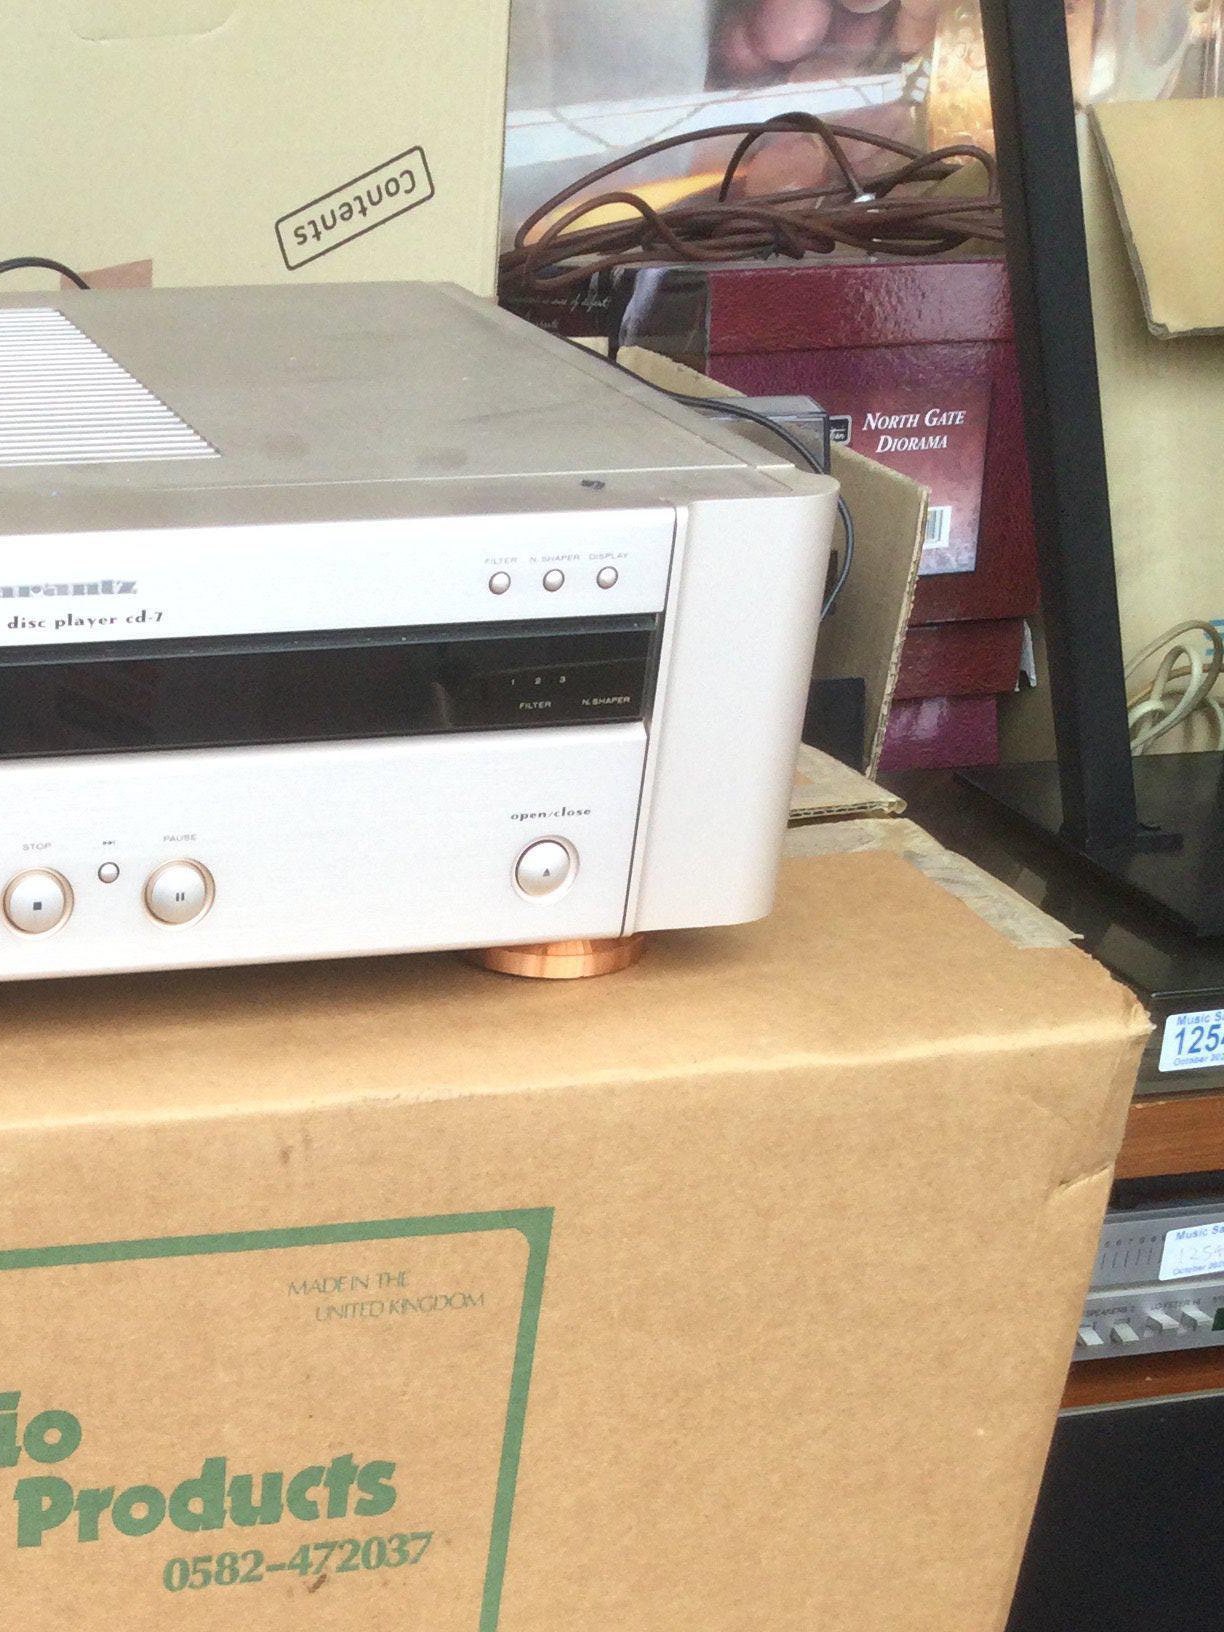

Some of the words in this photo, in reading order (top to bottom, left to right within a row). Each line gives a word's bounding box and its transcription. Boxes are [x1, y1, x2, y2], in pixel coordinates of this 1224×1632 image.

[862, 412, 920, 431] NORTH
[925, 408, 967, 427] GATE
[875, 435, 948, 453] DIORAMA
[484, 556, 518, 565] FILTER
[588, 552, 629, 561] DISPLAY
[7, 615, 46, 630] disc
[55, 613, 117, 630] player
[125, 609, 164, 625] cd-7
[535, 676, 542, 685] 2
[559, 675, 566, 684] 3
[519, 701, 552, 710] FILTER
[510, 806, 591, 822] open/close
[162, 833, 198, 843] PAUSE
[22, 841, 52, 851] STOP
[1176, 1013, 1210, 1026] Music
[1176, 1229, 1208, 1240] Music
[288, 1274, 345, 1296] MADE
[350, 1273, 370, 1291] IN
[377, 1270, 411, 1289] THE
[315, 1300, 385, 1322] UNITED
[389, 1292, 485, 1315] KINGDOM
[13, 1452, 398, 1548] Products
[162, 1530, 435, 1593] 0582-472037
